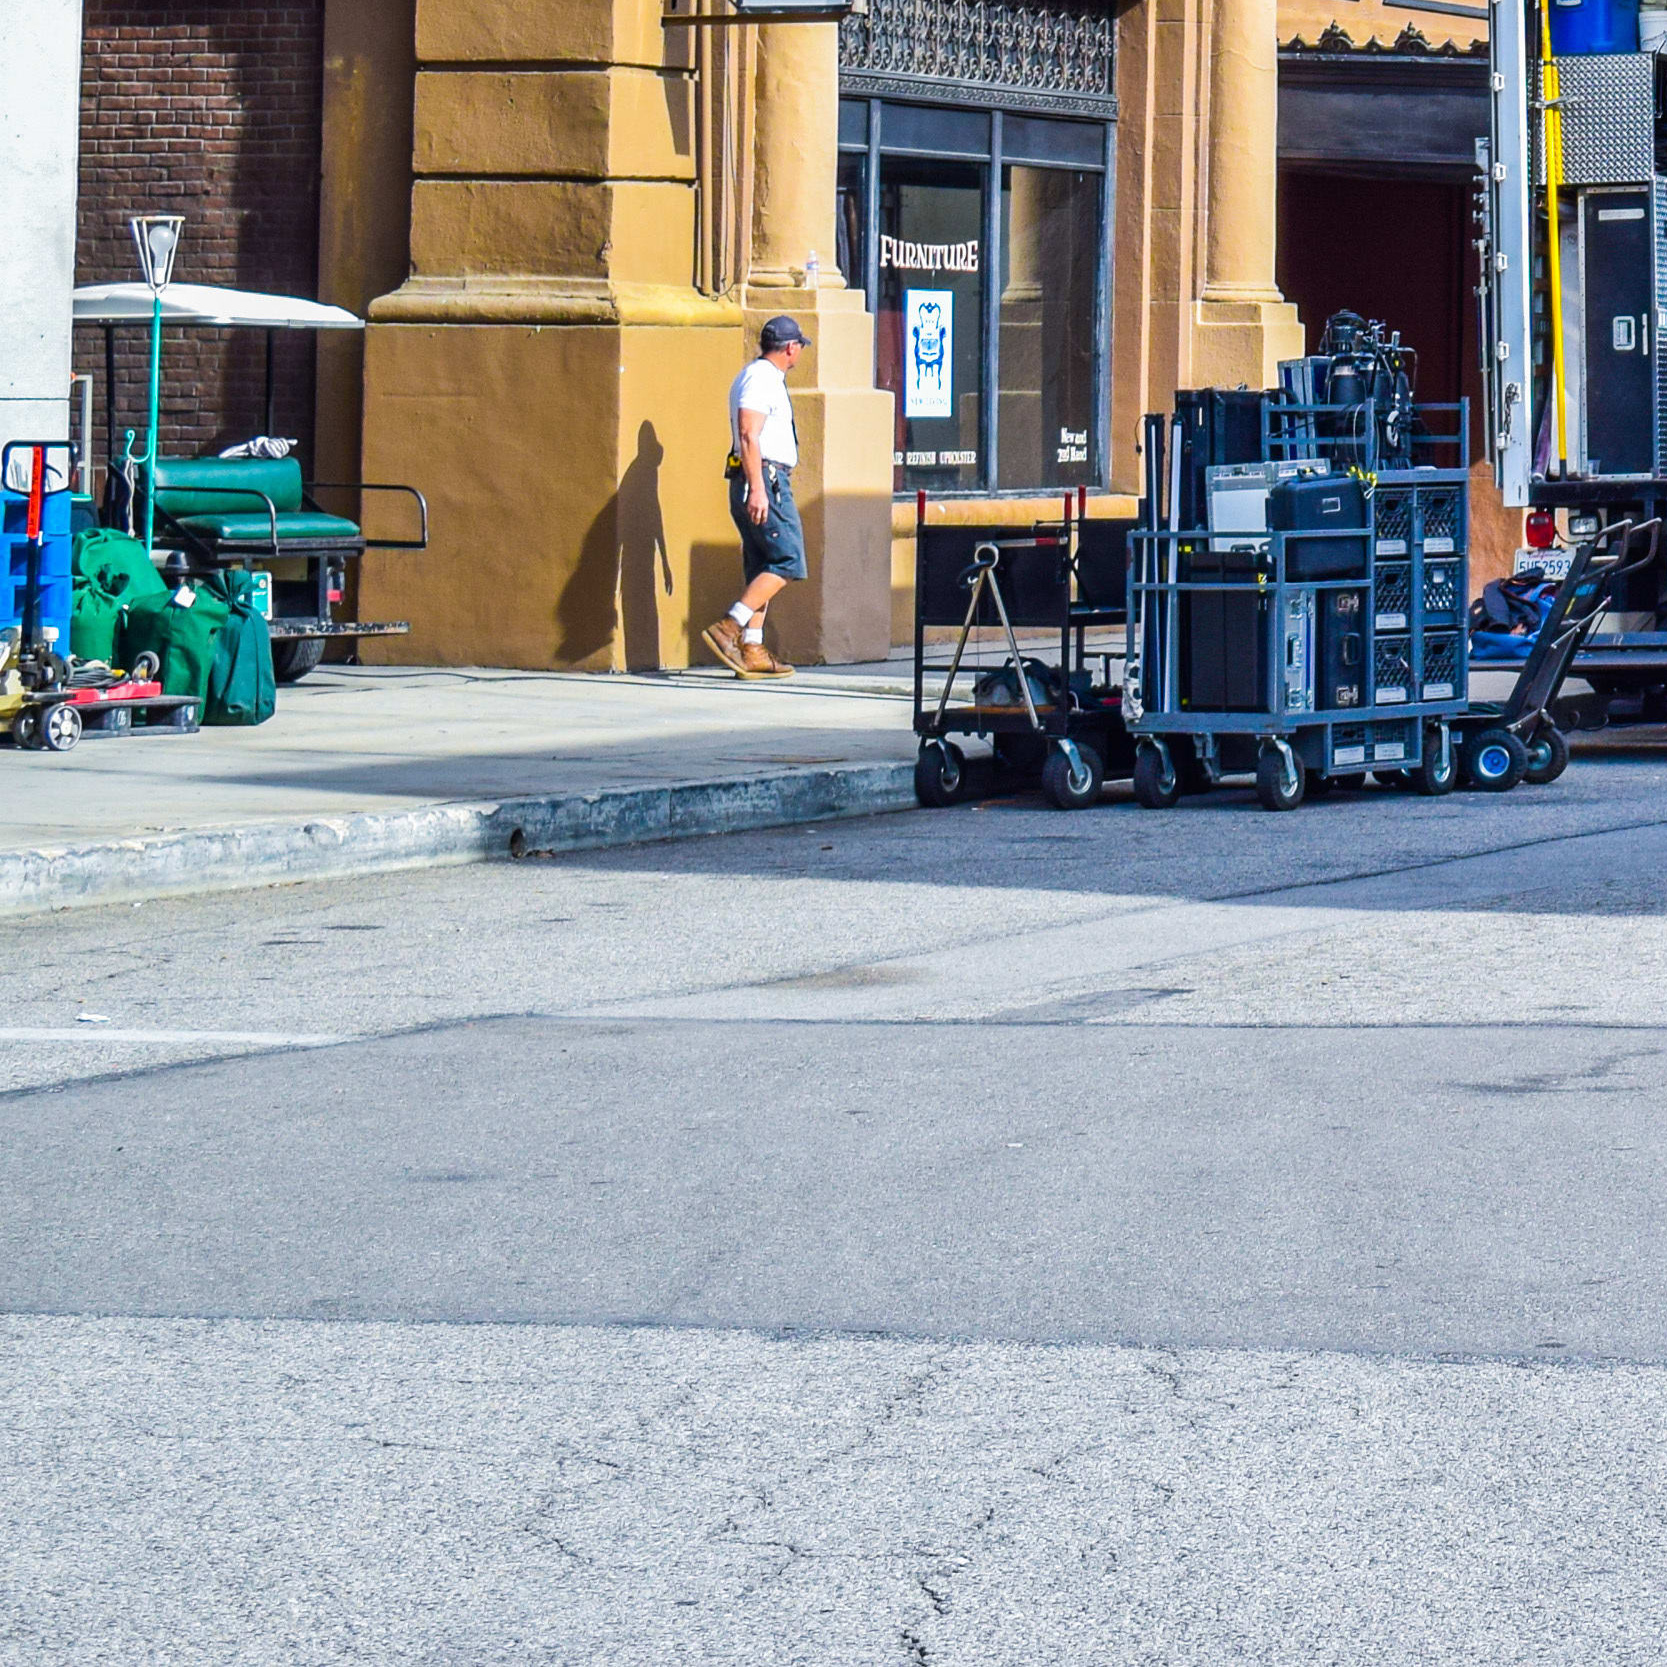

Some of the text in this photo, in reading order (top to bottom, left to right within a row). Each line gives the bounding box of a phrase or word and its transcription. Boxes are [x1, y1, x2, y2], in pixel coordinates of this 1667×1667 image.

[880, 235, 978, 271] FURNITURE
[1061, 427, 1074, 443] New
[906, 451, 937, 466] REFINISH
[1057, 445, 1070, 462] 2nd
